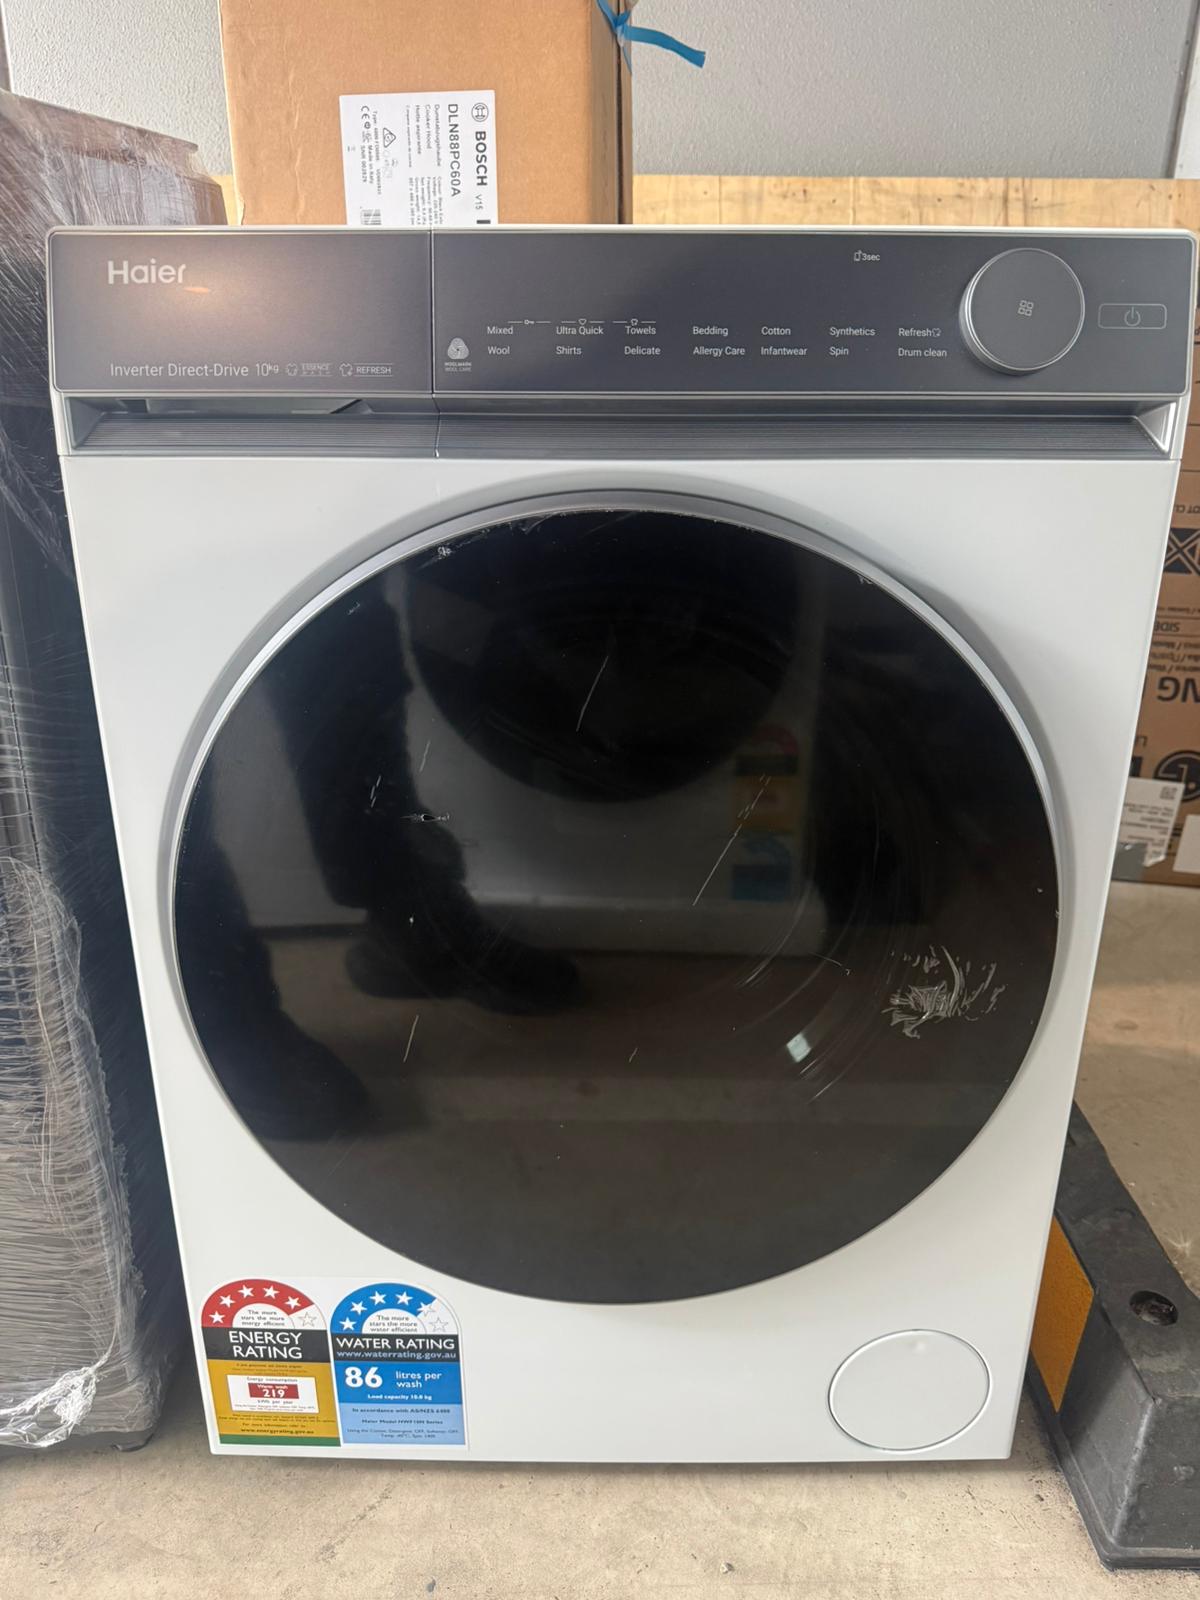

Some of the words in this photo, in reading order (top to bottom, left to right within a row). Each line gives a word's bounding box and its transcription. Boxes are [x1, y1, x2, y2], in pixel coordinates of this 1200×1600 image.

[447, 103, 461, 197] DLN88PC60A
[475, 130, 488, 186] BOSCH
[862, 253, 880, 261] 3sec
[108, 258, 186, 284] Haier
[487, 326, 514, 335] Mixed
[556, 326, 576, 335] Ultra
[579, 326, 603, 335] Quick
[625, 326, 656, 335] Towels
[693, 326, 728, 337] Bedding
[761, 326, 791, 336] Cotton
[829, 327, 875, 337] Synthetics
[899, 328, 932, 337] Refresh
[488, 346, 510, 355] Wool
[556, 347, 581, 355] Shirts
[624, 346, 661, 355] Delicate
[693, 346, 723, 357] Allergy
[725, 347, 745, 356] Care
[761, 347, 807, 356] Infantwear
[829, 347, 848, 356] Spin
[898, 348, 921, 357] Drum
[924, 348, 947, 357] clean
[110, 363, 163, 376] Inverter
[168, 363, 248, 376] Direct-Drive
[356, 366, 392, 374] REFRESH
[229, 1331, 301, 1344] ENERGY
[336, 1337, 391, 1349] WATER
[396, 1339, 454, 1349] RATING
[233, 1346, 302, 1359] RATING
[337, 1351, 456, 1359] www.waterrating.gov.au
[345, 1367, 382, 1388] 86
[396, 1371, 421, 1379] litres
[425, 1372, 442, 1381] per
[396, 1380, 422, 1388] wash
[263, 1389, 285, 1398] 219
